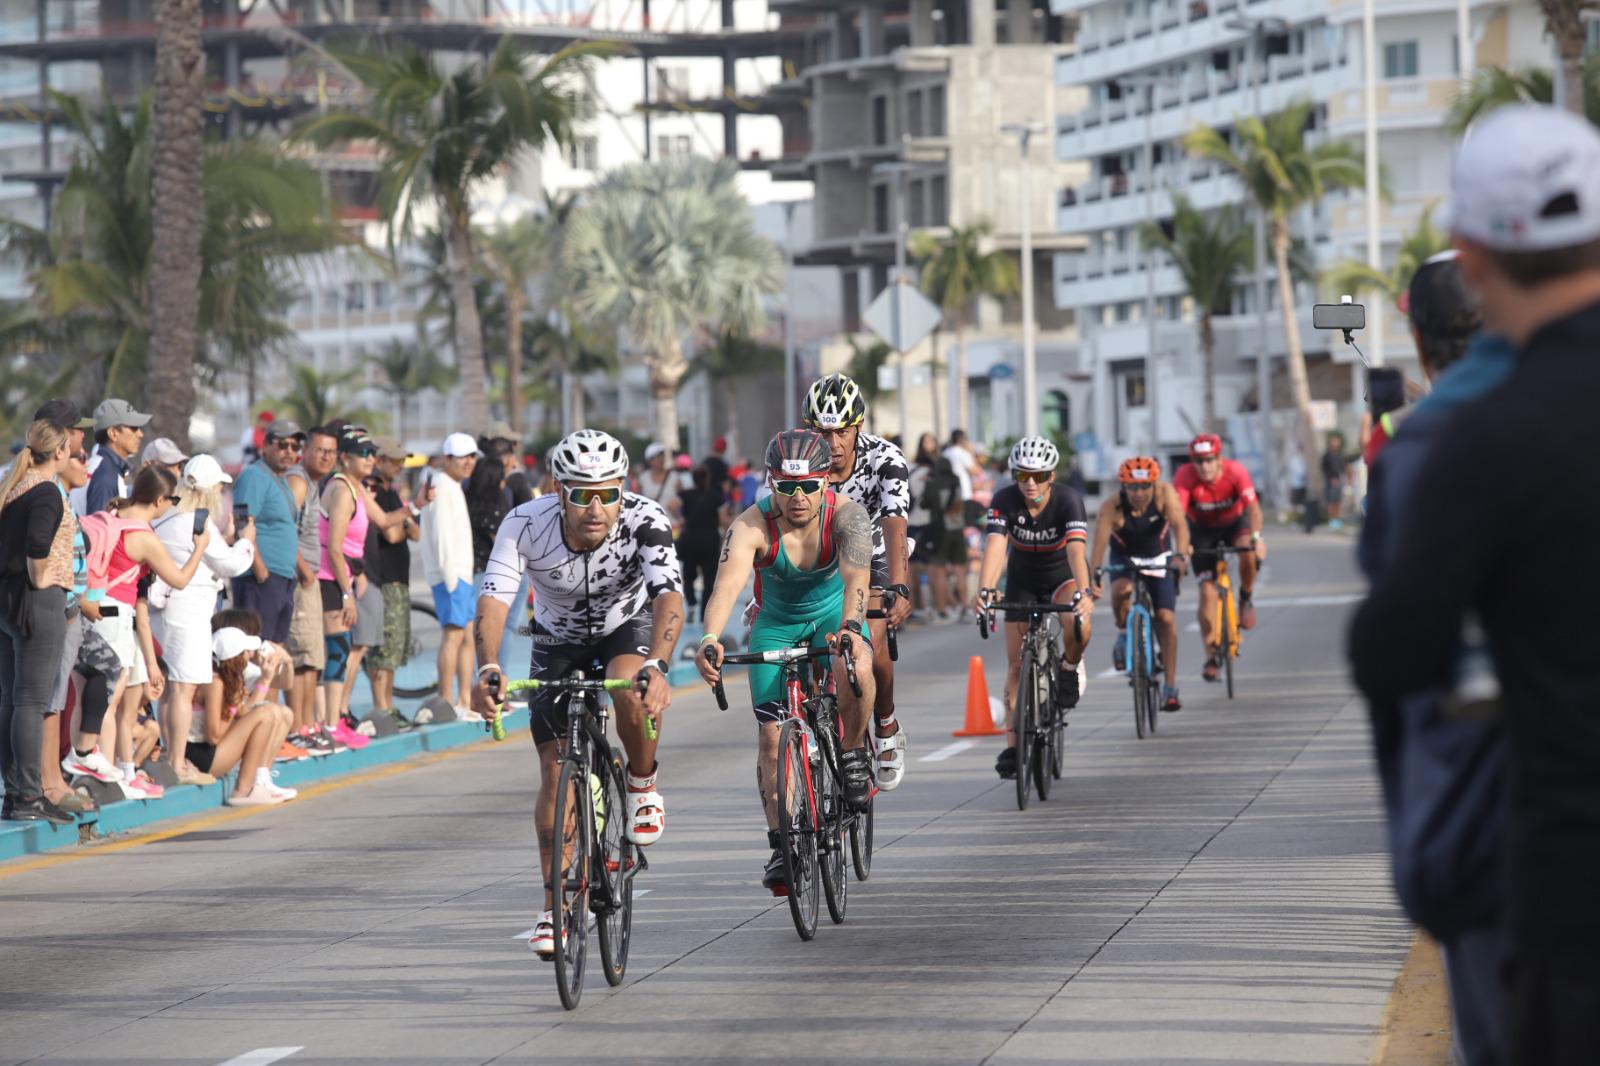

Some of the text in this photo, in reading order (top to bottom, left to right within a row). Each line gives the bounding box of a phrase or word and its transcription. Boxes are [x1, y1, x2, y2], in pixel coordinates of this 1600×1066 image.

[589, 455, 601, 463] 76
[790, 463, 801, 471] 93
[1013, 525, 1058, 541] TRIMAZ
[663, 611, 679, 642] 76
[643, 776, 655, 786] 76
